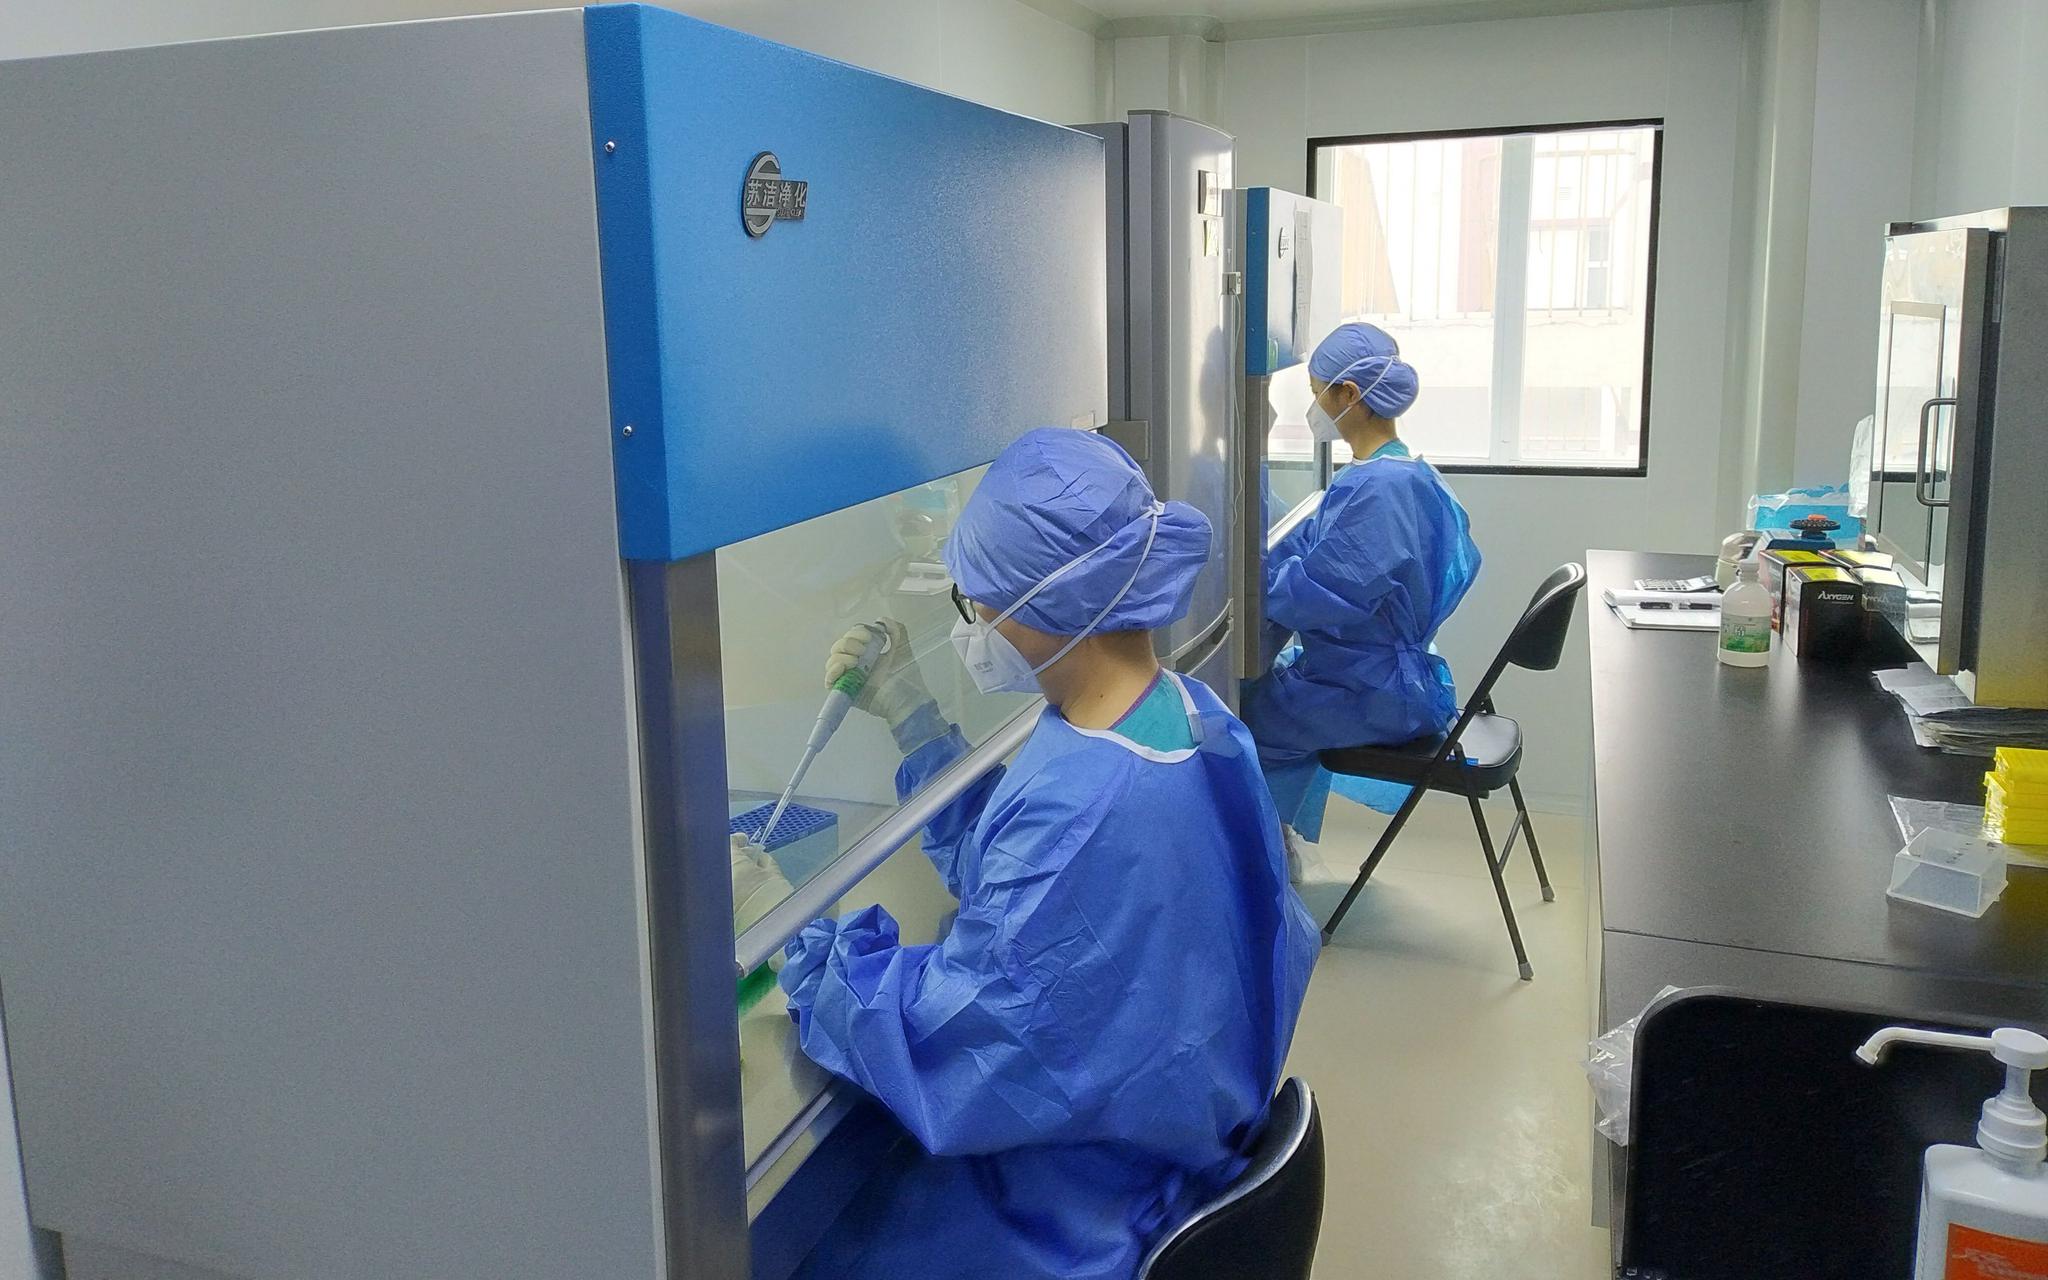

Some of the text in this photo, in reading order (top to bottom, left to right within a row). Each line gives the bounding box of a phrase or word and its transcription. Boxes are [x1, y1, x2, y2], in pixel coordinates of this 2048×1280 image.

[747, 180, 806, 207] 苏洁净化
[1818, 591, 1854, 600] AXYGEN
